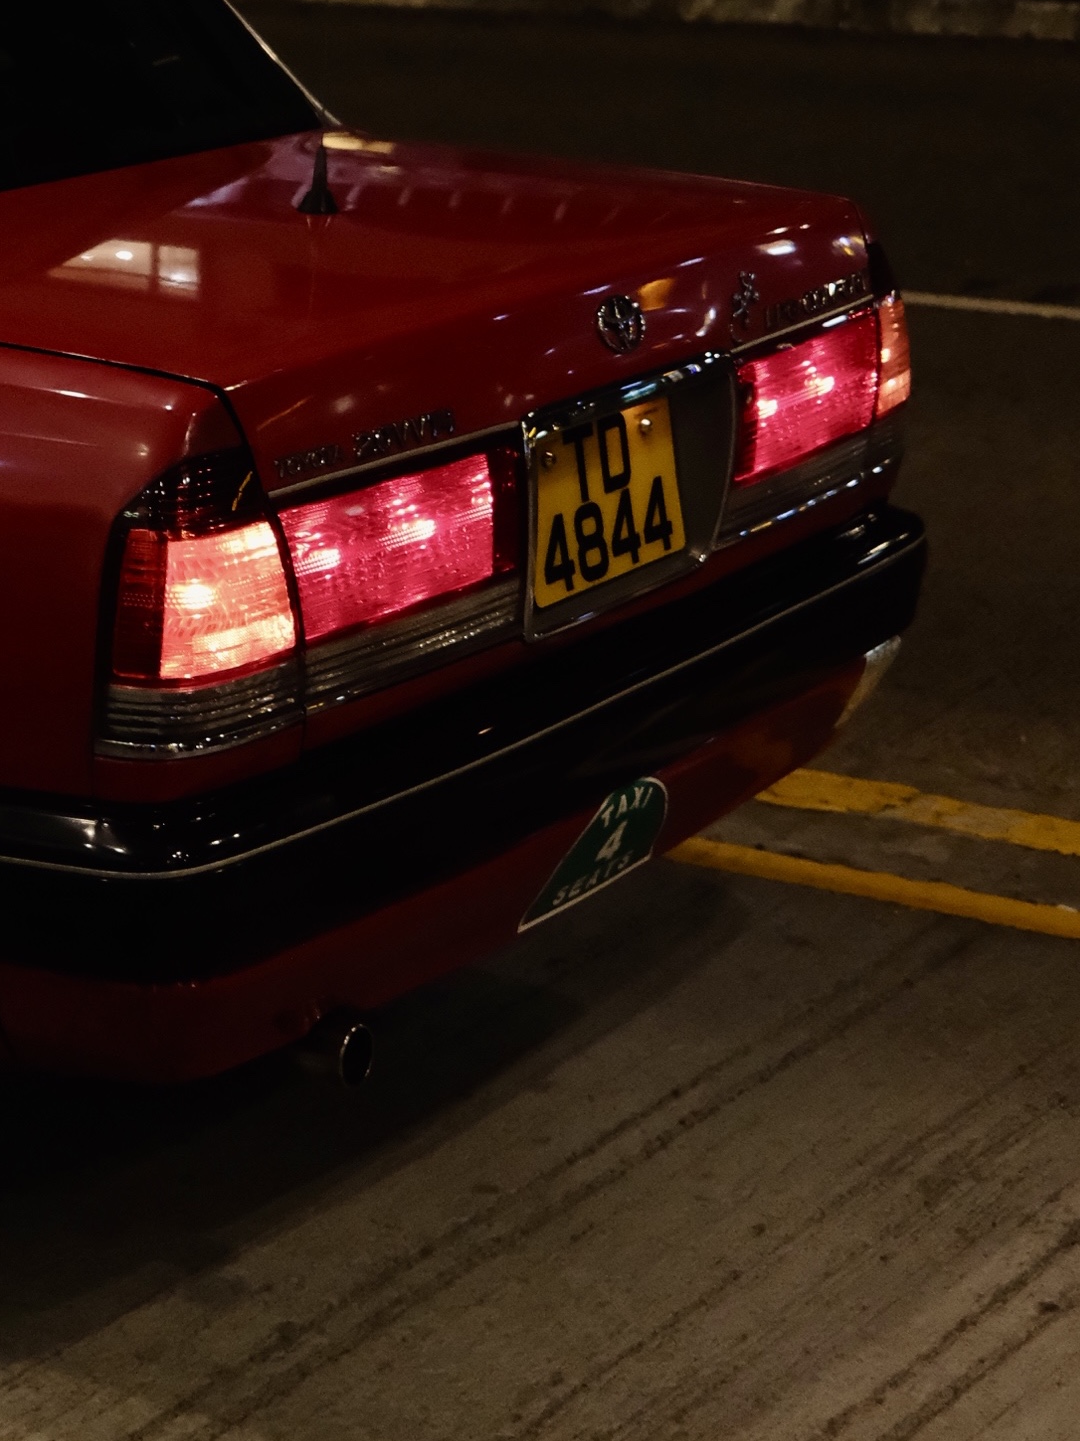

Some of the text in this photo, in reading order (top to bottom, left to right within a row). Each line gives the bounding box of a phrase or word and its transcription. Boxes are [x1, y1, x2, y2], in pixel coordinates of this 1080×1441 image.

[562, 411, 632, 502] TD
[544, 476, 674, 592] 4844
[601, 786, 653, 828] TAXI
[595, 820, 628, 862] 4
[552, 849, 635, 906] SEATS
